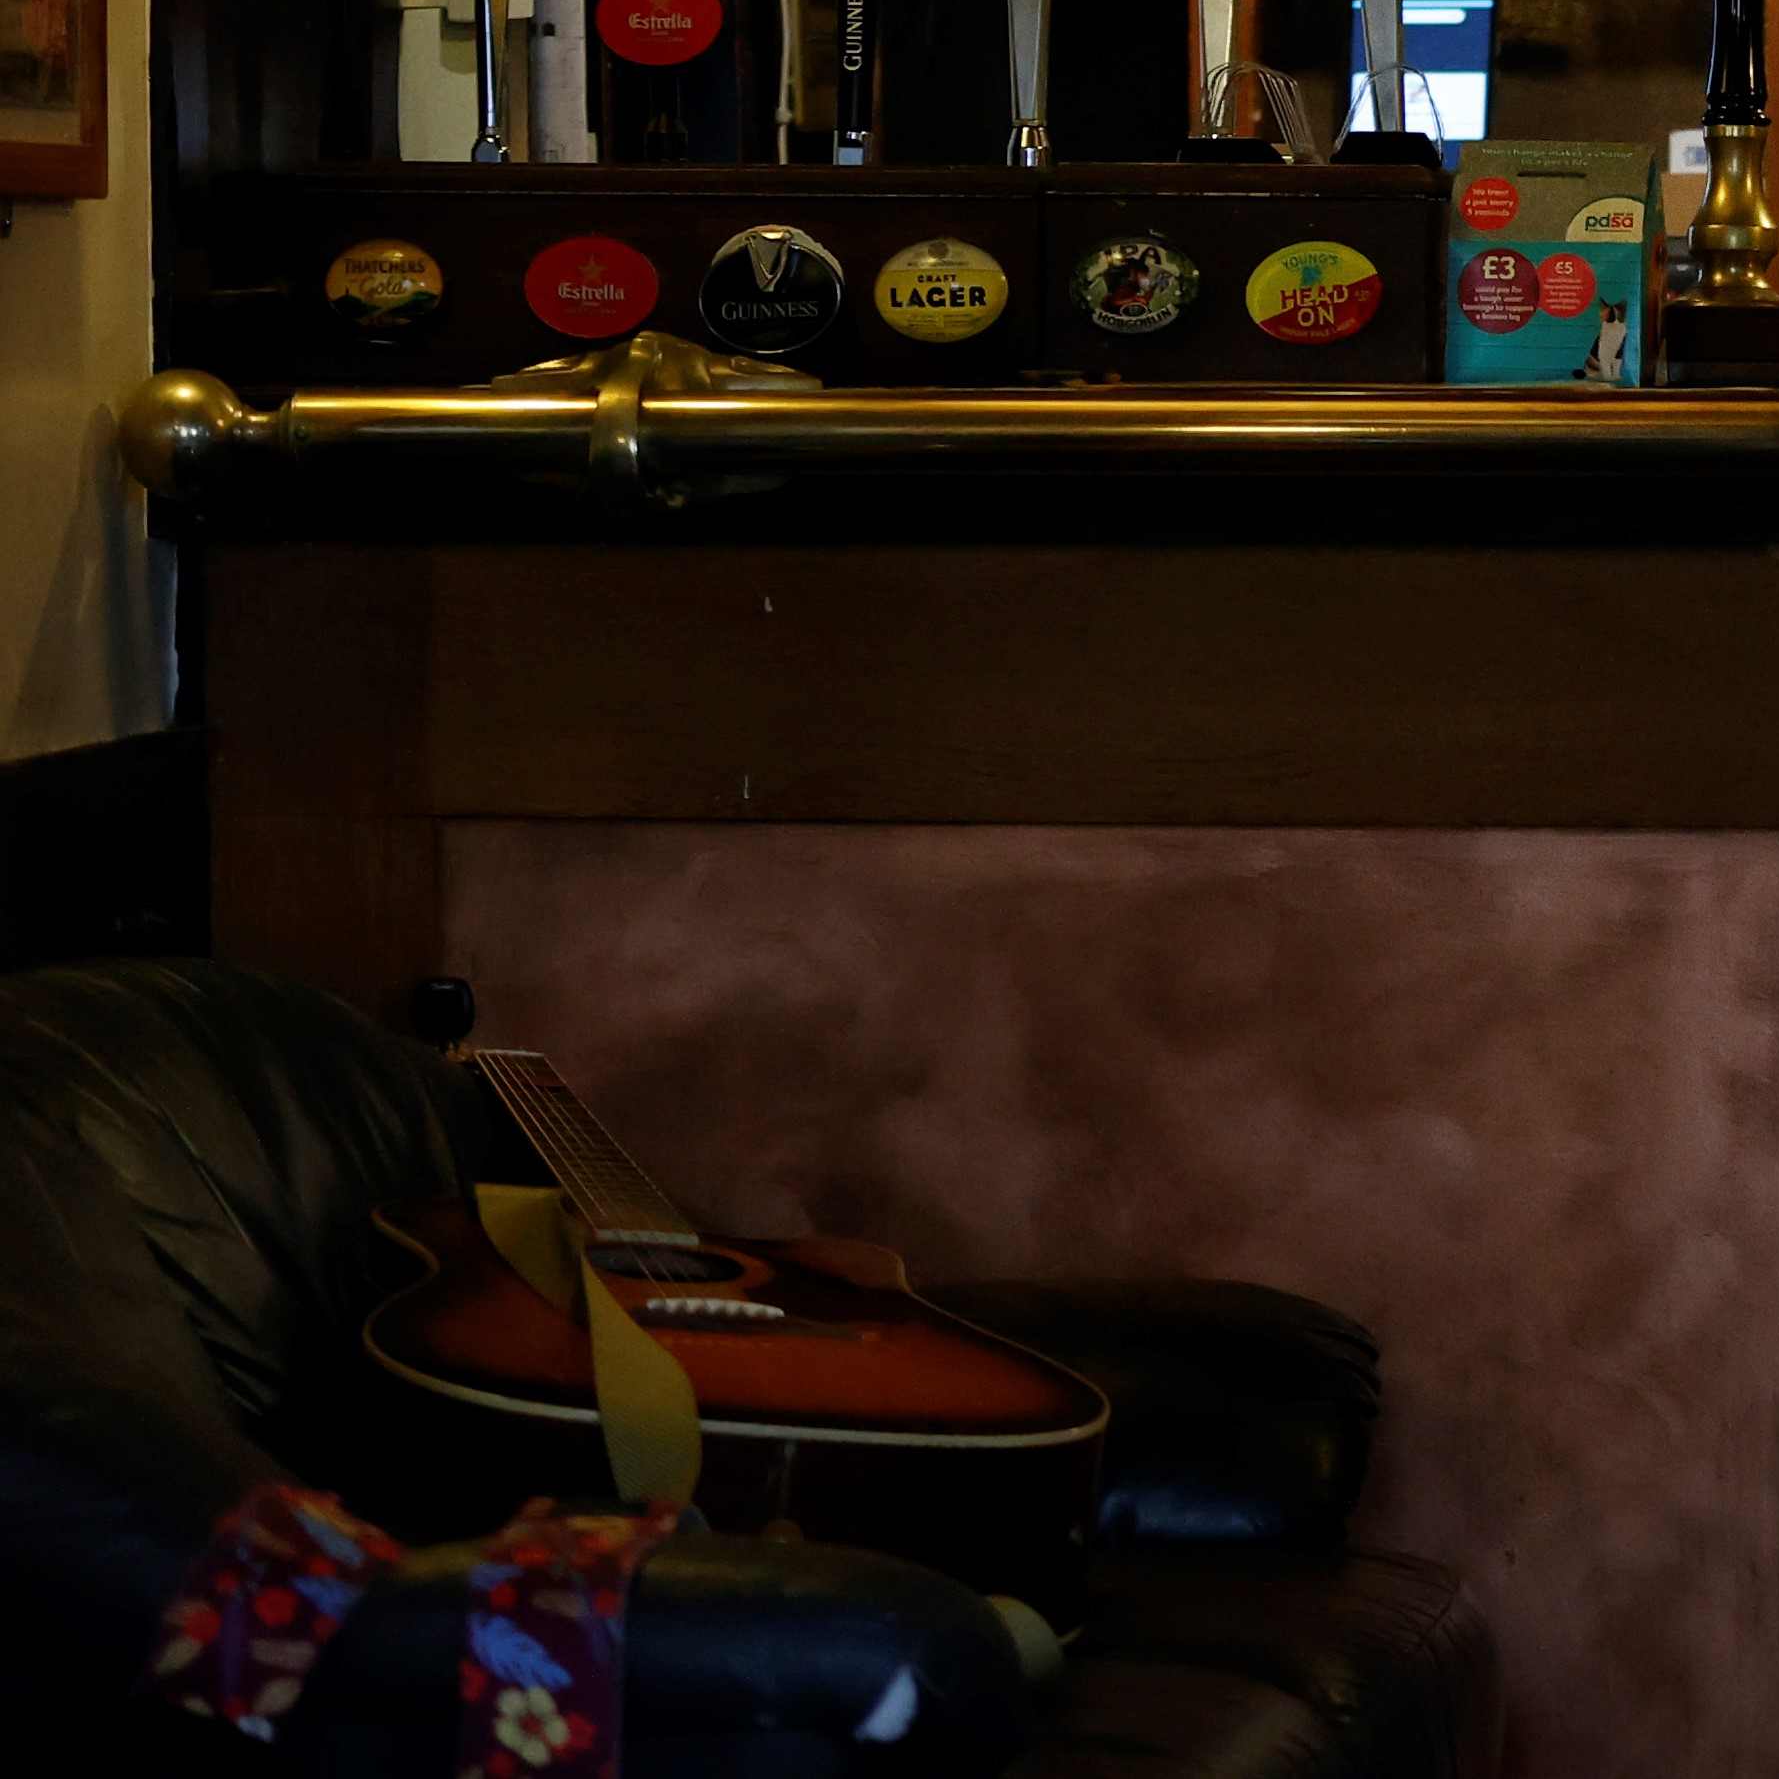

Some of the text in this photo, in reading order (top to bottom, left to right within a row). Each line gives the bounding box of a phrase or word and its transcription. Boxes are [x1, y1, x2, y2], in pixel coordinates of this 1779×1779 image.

[627, 12, 695, 30] Estrella
[1584, 213, 1634, 231] pdsa
[343, 257, 426, 274] THATCHERS
[1281, 252, 1341, 270] YOUNG'S
[1482, 256, 1516, 280] £3
[1554, 261, 1574, 275] £5
[917, 274, 958, 284] CRAFT
[557, 280, 626, 302] Estrella
[889, 286, 988, 308] LAGER
[1279, 283, 1350, 311] HEAD
[720, 299, 822, 321] GUINNESS
[1096, 303, 1174, 328] HOBGOBLIN
[1296, 305, 1336, 327] ON
